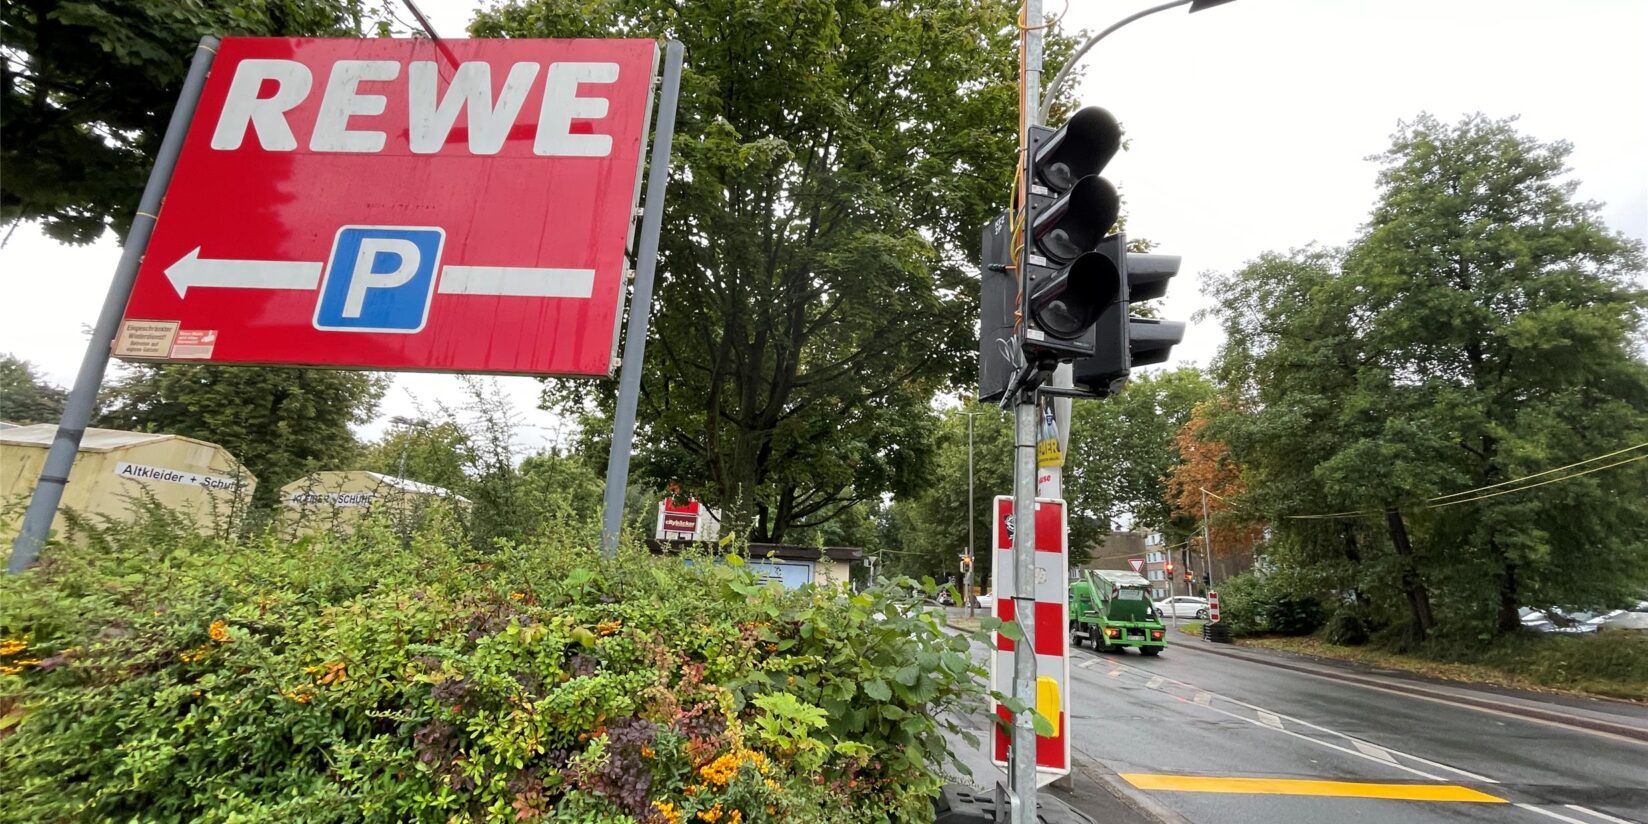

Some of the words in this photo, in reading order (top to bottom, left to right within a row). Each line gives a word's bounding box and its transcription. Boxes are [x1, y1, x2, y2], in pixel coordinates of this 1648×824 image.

[210, 58, 620, 157] REWE
[341, 238, 421, 318] P
[122, 464, 184, 483] Altkleider
